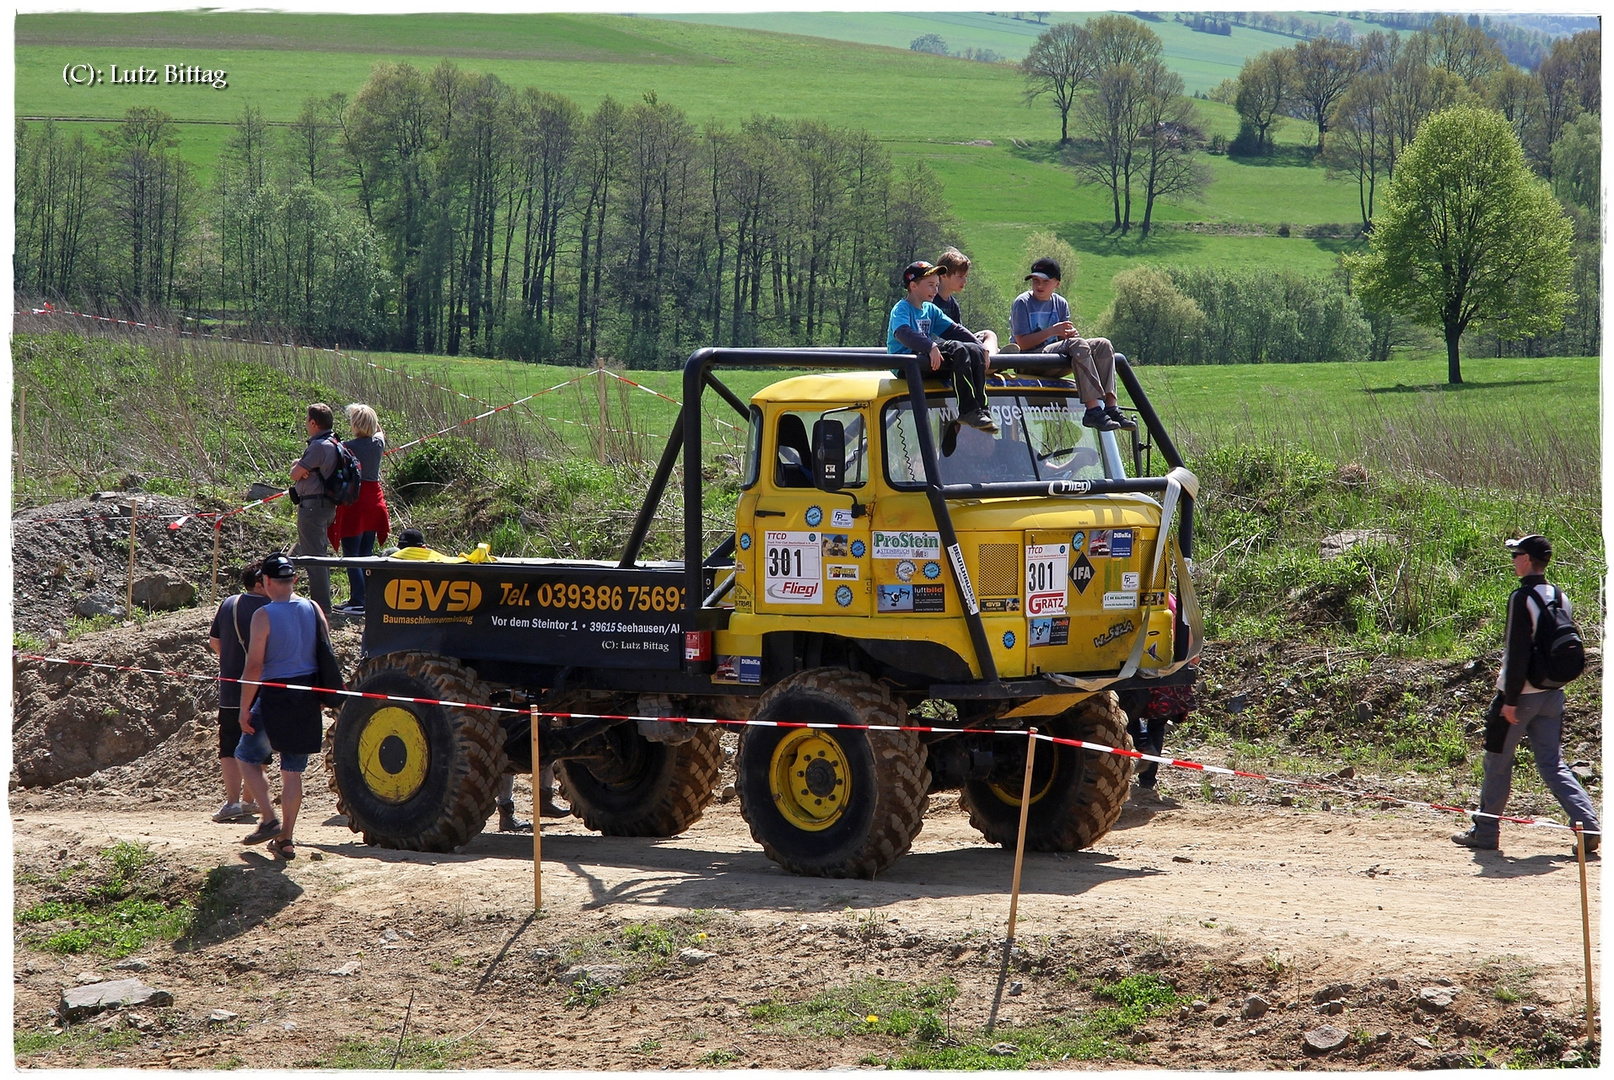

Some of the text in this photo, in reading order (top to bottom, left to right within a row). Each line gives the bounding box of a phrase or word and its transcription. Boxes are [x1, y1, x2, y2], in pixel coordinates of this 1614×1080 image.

[767, 532, 787, 540] TTCD
[873, 532, 939, 548] ProStein
[1028, 546, 1044, 555] TTCD
[768, 548, 802, 577] 301
[1029, 562, 1053, 592] 301
[1073, 566, 1091, 581] IFA
[393, 579, 474, 612] BVS
[499, 582, 530, 606] Tel.
[537, 582, 623, 611] 039386
[782, 581, 819, 598] Fliegl
[383, 614, 474, 625] Baumaschinenvermietung
[491, 616, 508, 627] Vor
[510, 616, 530, 628] dem
[532, 618, 569, 630] Steintor
[571, 620, 578, 631] 1
[590, 621, 616, 633] 39615
